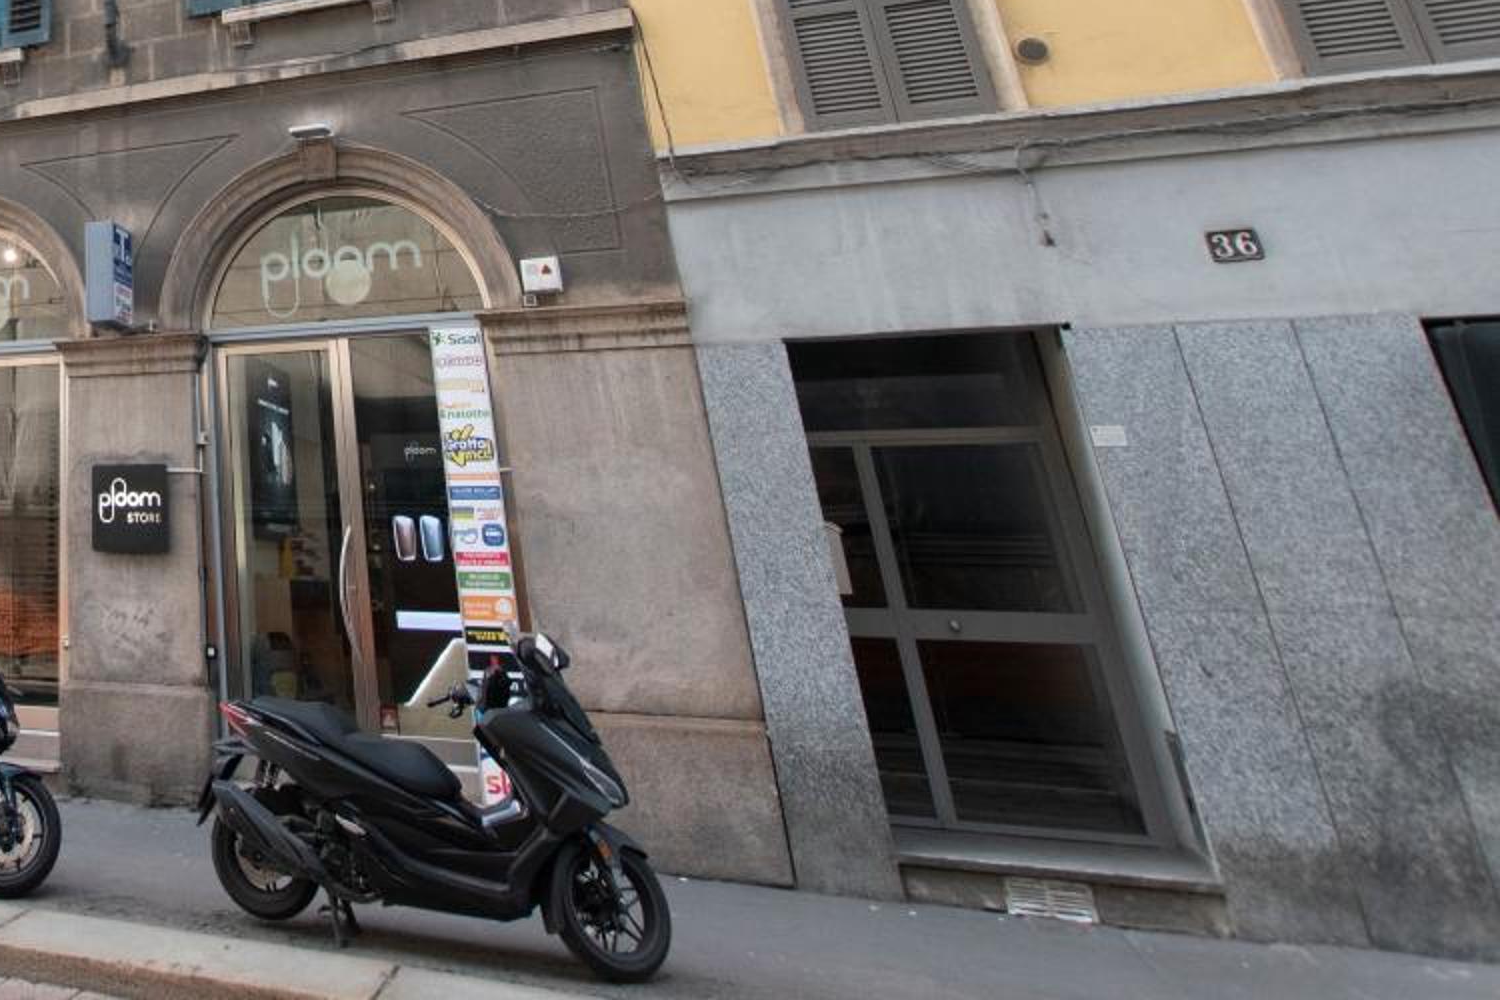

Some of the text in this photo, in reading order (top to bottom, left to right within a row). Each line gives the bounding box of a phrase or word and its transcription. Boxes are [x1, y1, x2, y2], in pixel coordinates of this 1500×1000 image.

[1211, 231, 1258, 258] 36
[261, 227, 422, 319] ploom
[99, 477, 161, 523] ploom
[127, 511, 162, 524] STORE
